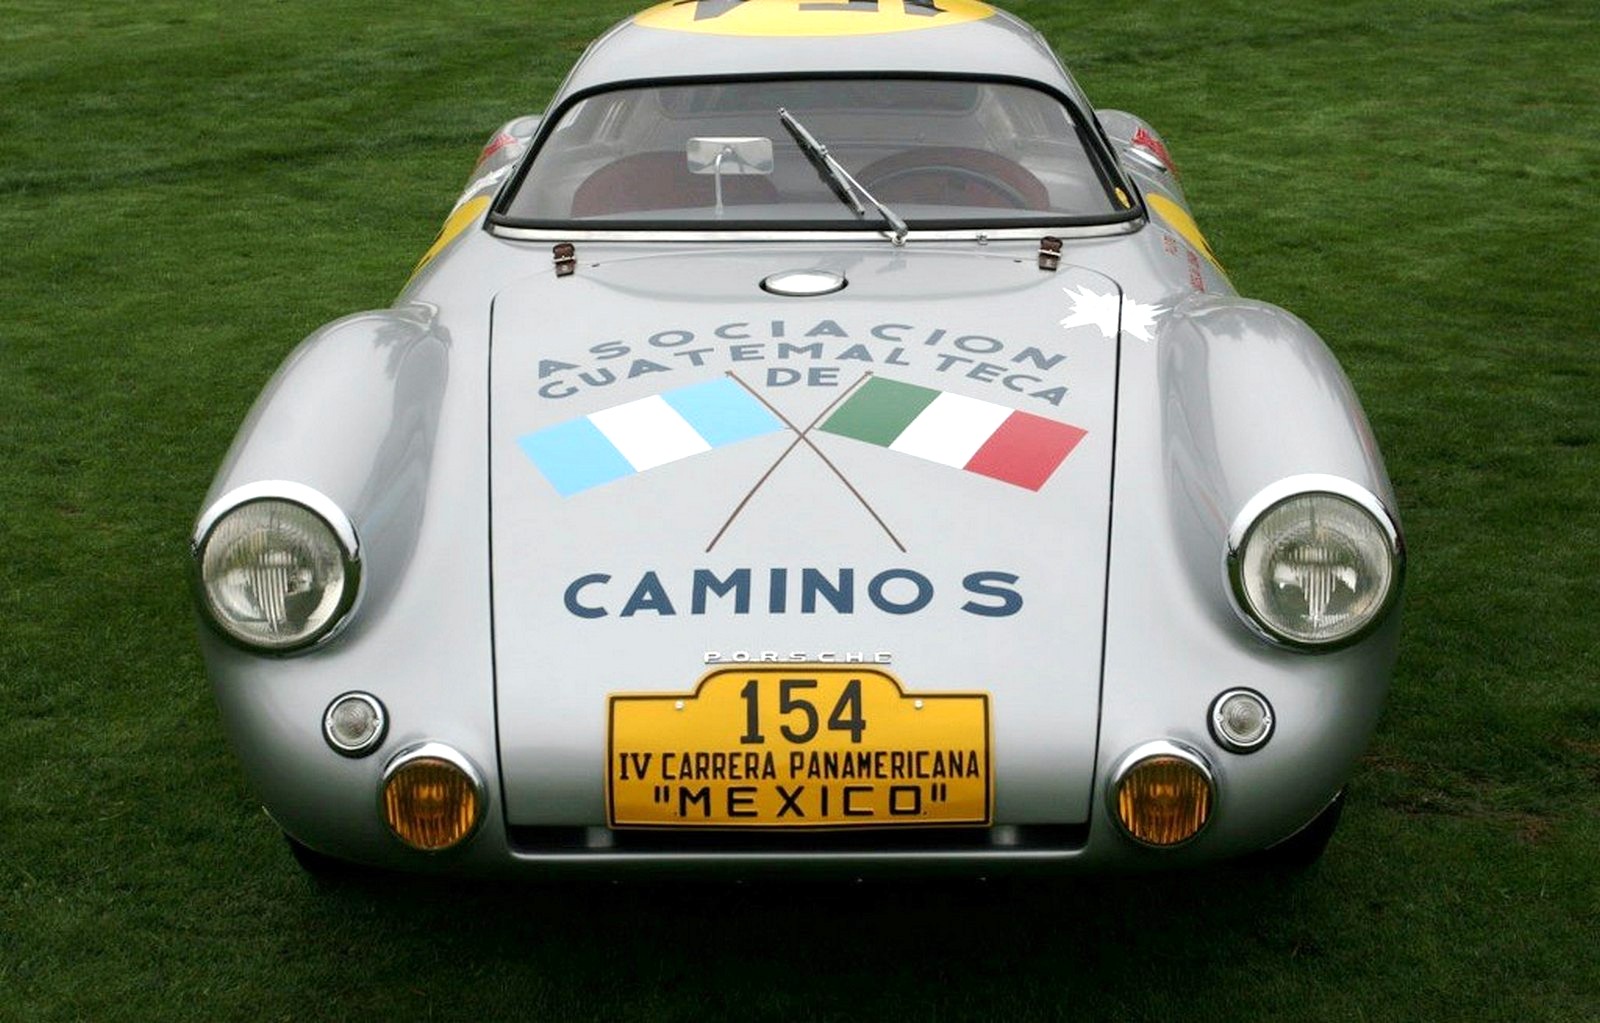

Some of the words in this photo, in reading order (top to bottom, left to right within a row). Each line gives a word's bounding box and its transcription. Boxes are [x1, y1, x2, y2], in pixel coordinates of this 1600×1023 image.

[538, 319, 1067, 379] ASOCIACION
[766, 366, 840, 388] DE
[563, 567, 1024, 620] CAMINOS
[703, 650, 893, 664] PORSCHE
[739, 678, 867, 745] 154
[619, 752, 653, 781] IV
[661, 751, 777, 782] CARRERA
[789, 749, 980, 781] PANAMERICANA
[653, 782, 948, 818] "MEXICO"
